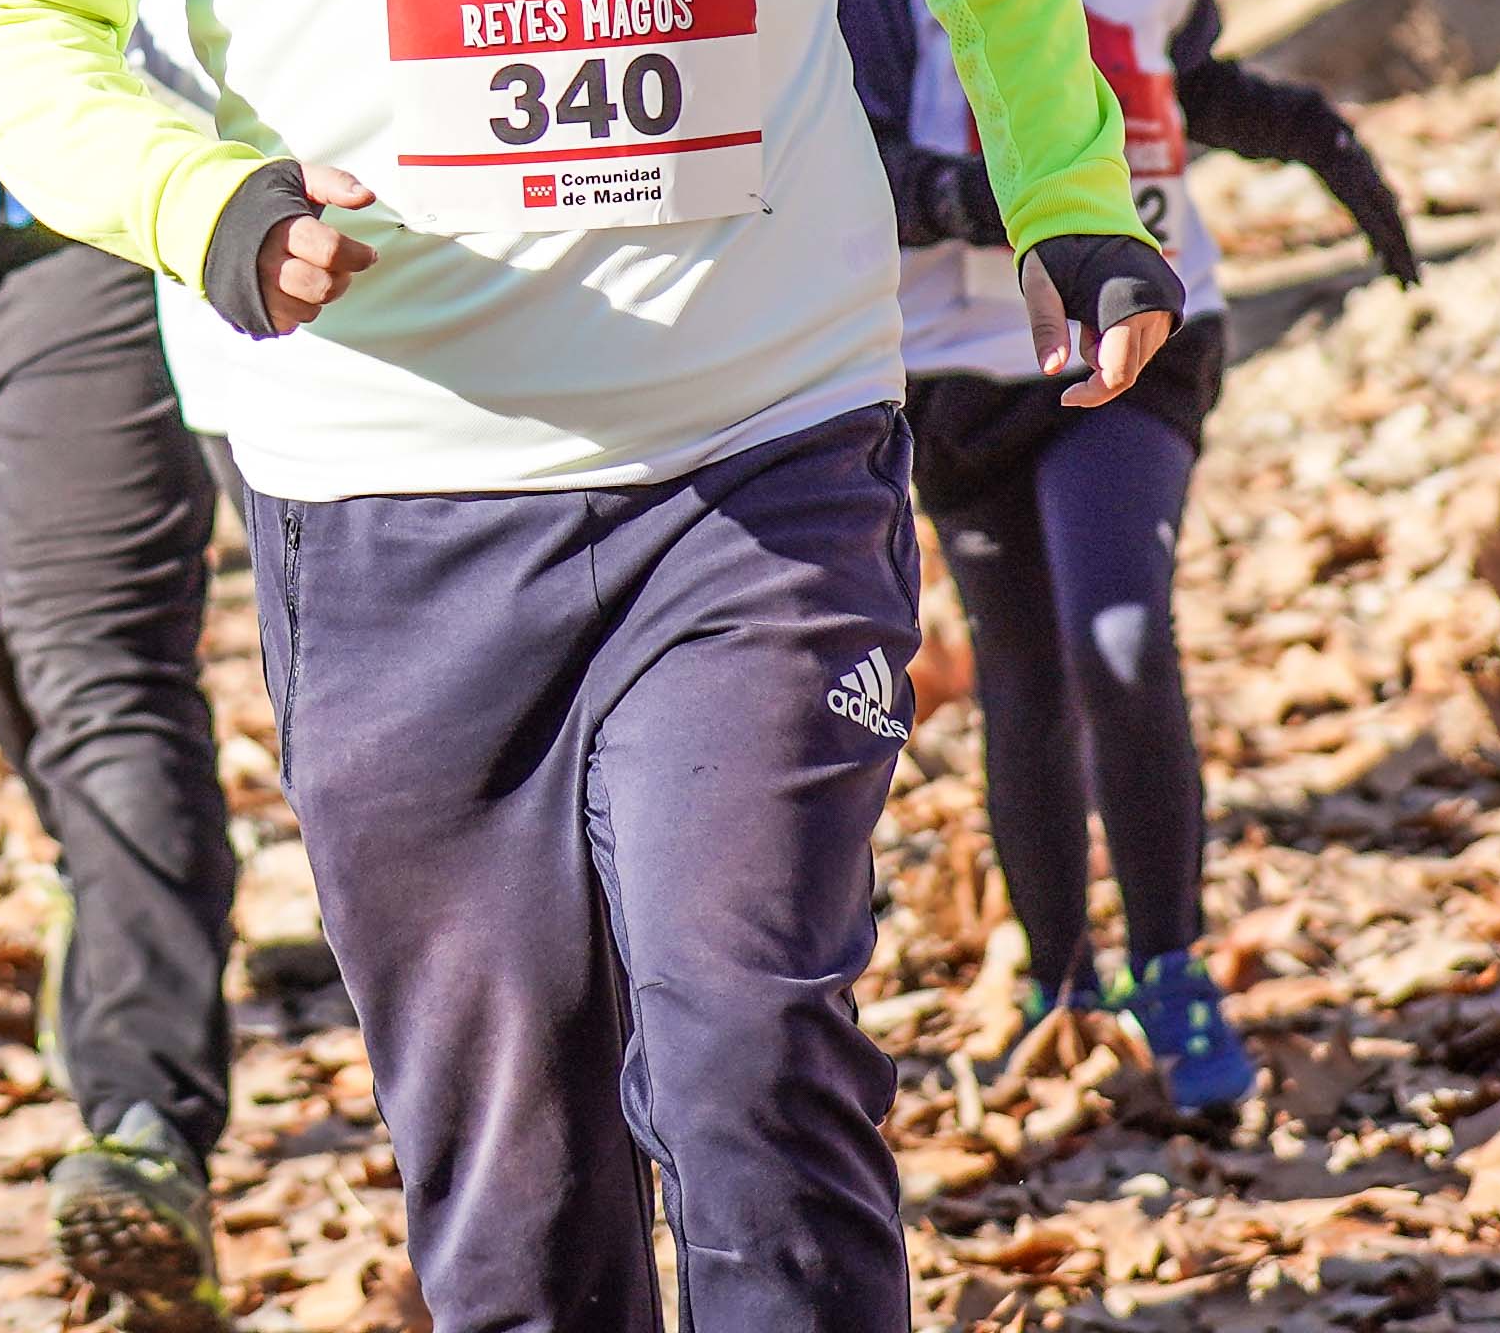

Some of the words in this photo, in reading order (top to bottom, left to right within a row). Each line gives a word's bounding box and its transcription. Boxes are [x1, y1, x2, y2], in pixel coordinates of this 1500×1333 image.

[461, 0, 567, 48] REYES
[489, 53, 682, 145] 340
[561, 167, 661, 186] Comunidad
[562, 192, 586, 206] de
[594, 186, 662, 205] Madrid
[827, 688, 909, 741] adidas
